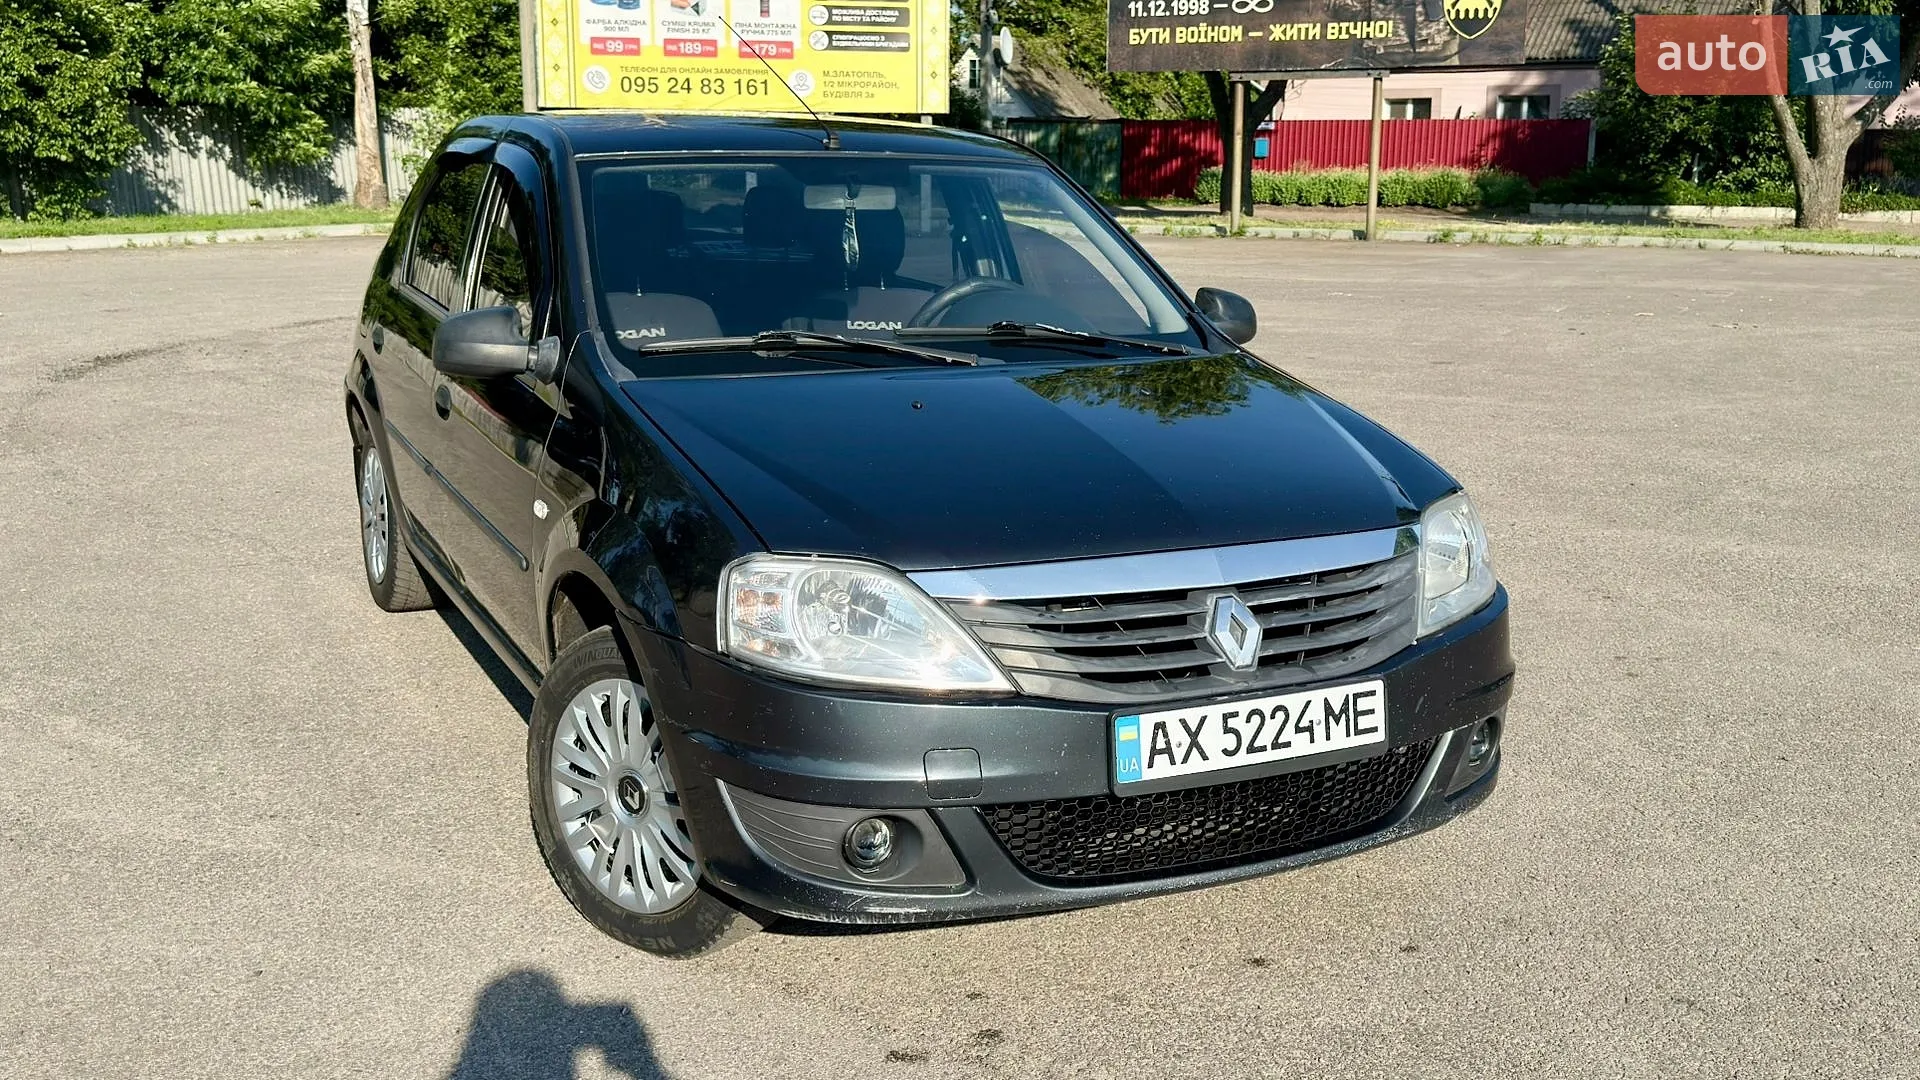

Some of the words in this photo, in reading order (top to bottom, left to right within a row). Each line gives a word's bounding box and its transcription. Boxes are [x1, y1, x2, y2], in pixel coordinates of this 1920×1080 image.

[1128, 0, 1209, 17] 11.12.1998
[1129, 27, 1170, 45] БУТИ
[1175, 22, 1243, 43] ВОЇНОМ
[1269, 23, 1321, 41] ЖИТИ
[1326, 20, 1393, 40] ВІЧНО!
[605, 39, 624, 53] 99
[678, 41, 702, 54] 189
[752, 43, 777, 56] 179
[660, 66, 677, 74] ДЛЯ
[679, 66, 713, 74] ОНЛАЙН
[714, 67, 769, 75] ЗАМОВЛЕННЯ
[620, 76, 659, 94] 095
[667, 77, 692, 94] 24
[700, 77, 725, 95] 83
[734, 78, 769, 96] 161
[823, 91, 863, 99] БУДІВЛЯ
[847, 320, 902, 331] LOGAN
[1147, 714, 1209, 769] AX
[1221, 699, 1315, 757] 5224
[1323, 689, 1379, 742] ME
[1119, 757, 1140, 773] UA
